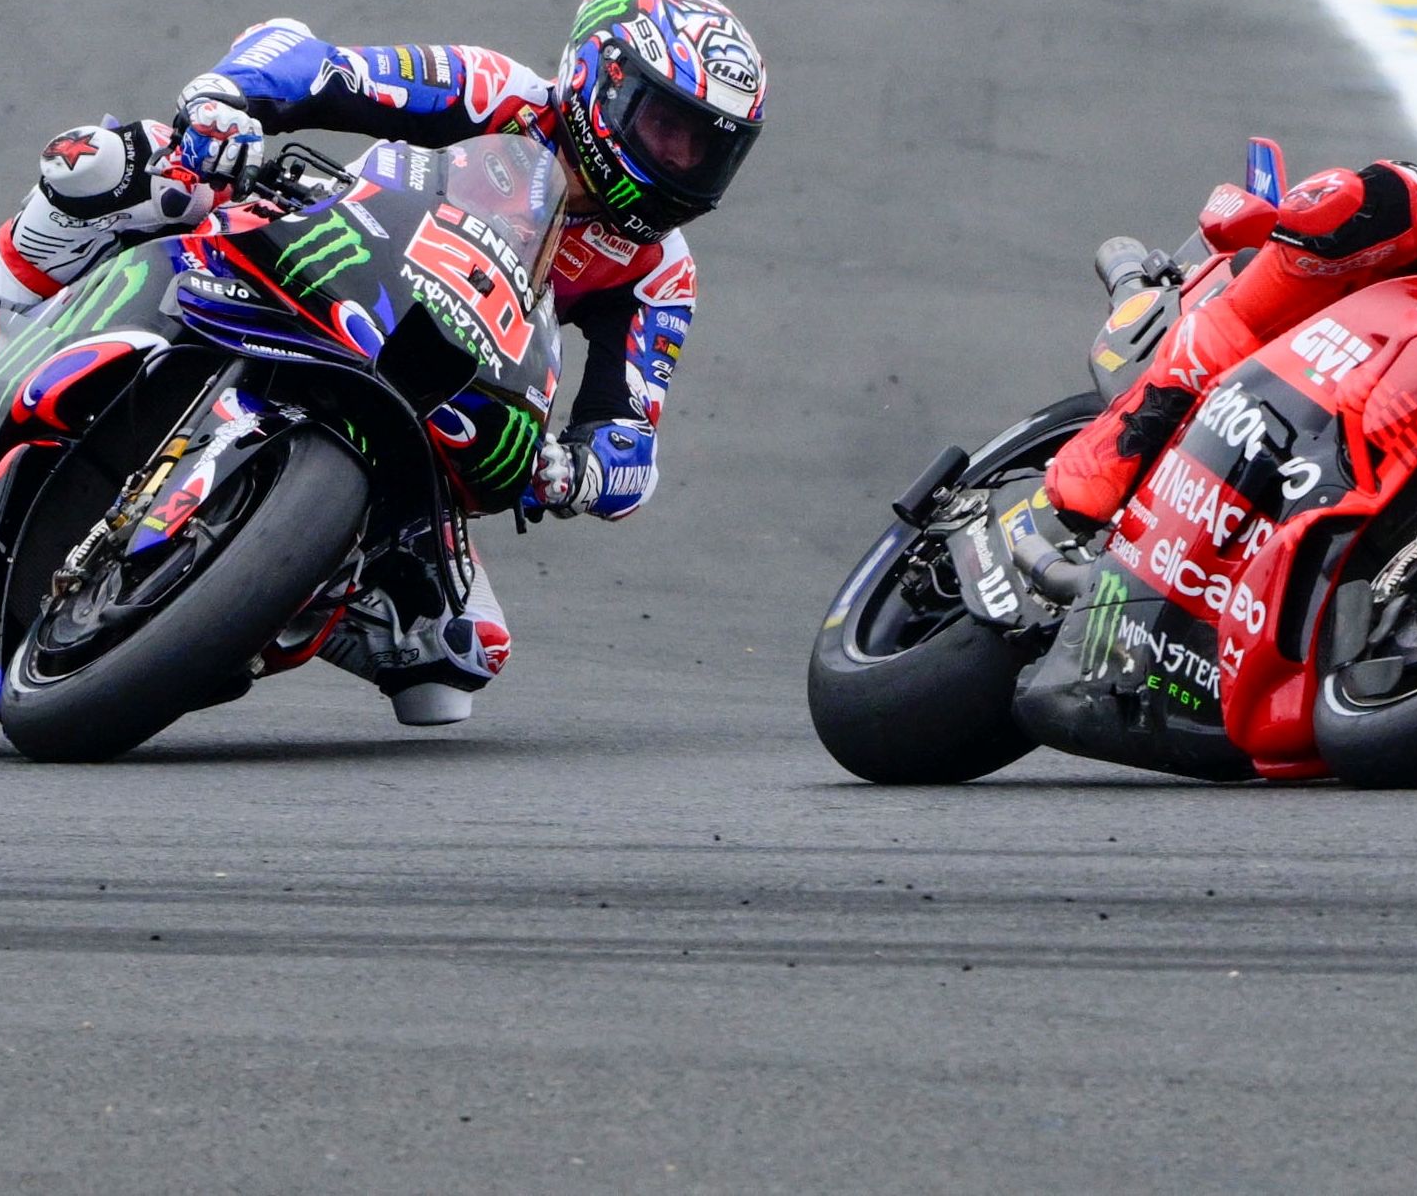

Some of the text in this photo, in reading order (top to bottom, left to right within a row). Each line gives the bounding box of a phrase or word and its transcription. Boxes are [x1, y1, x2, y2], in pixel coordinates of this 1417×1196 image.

[232, 30, 306, 68] YAMAHA
[636, 19, 663, 61] BS
[710, 63, 756, 88] HJC
[113, 165, 135, 198] RACING
[461, 214, 534, 312] ENEOS
[190, 275, 250, 300] REEJO
[404, 210, 534, 365] 20
[400, 263, 503, 380] MONSTER
[412, 291, 486, 366] ENERGY
[606, 464, 652, 496] YAMAHA
[1111, 533, 1143, 570] SIEMENS
[1118, 614, 1222, 700] MONSTER
